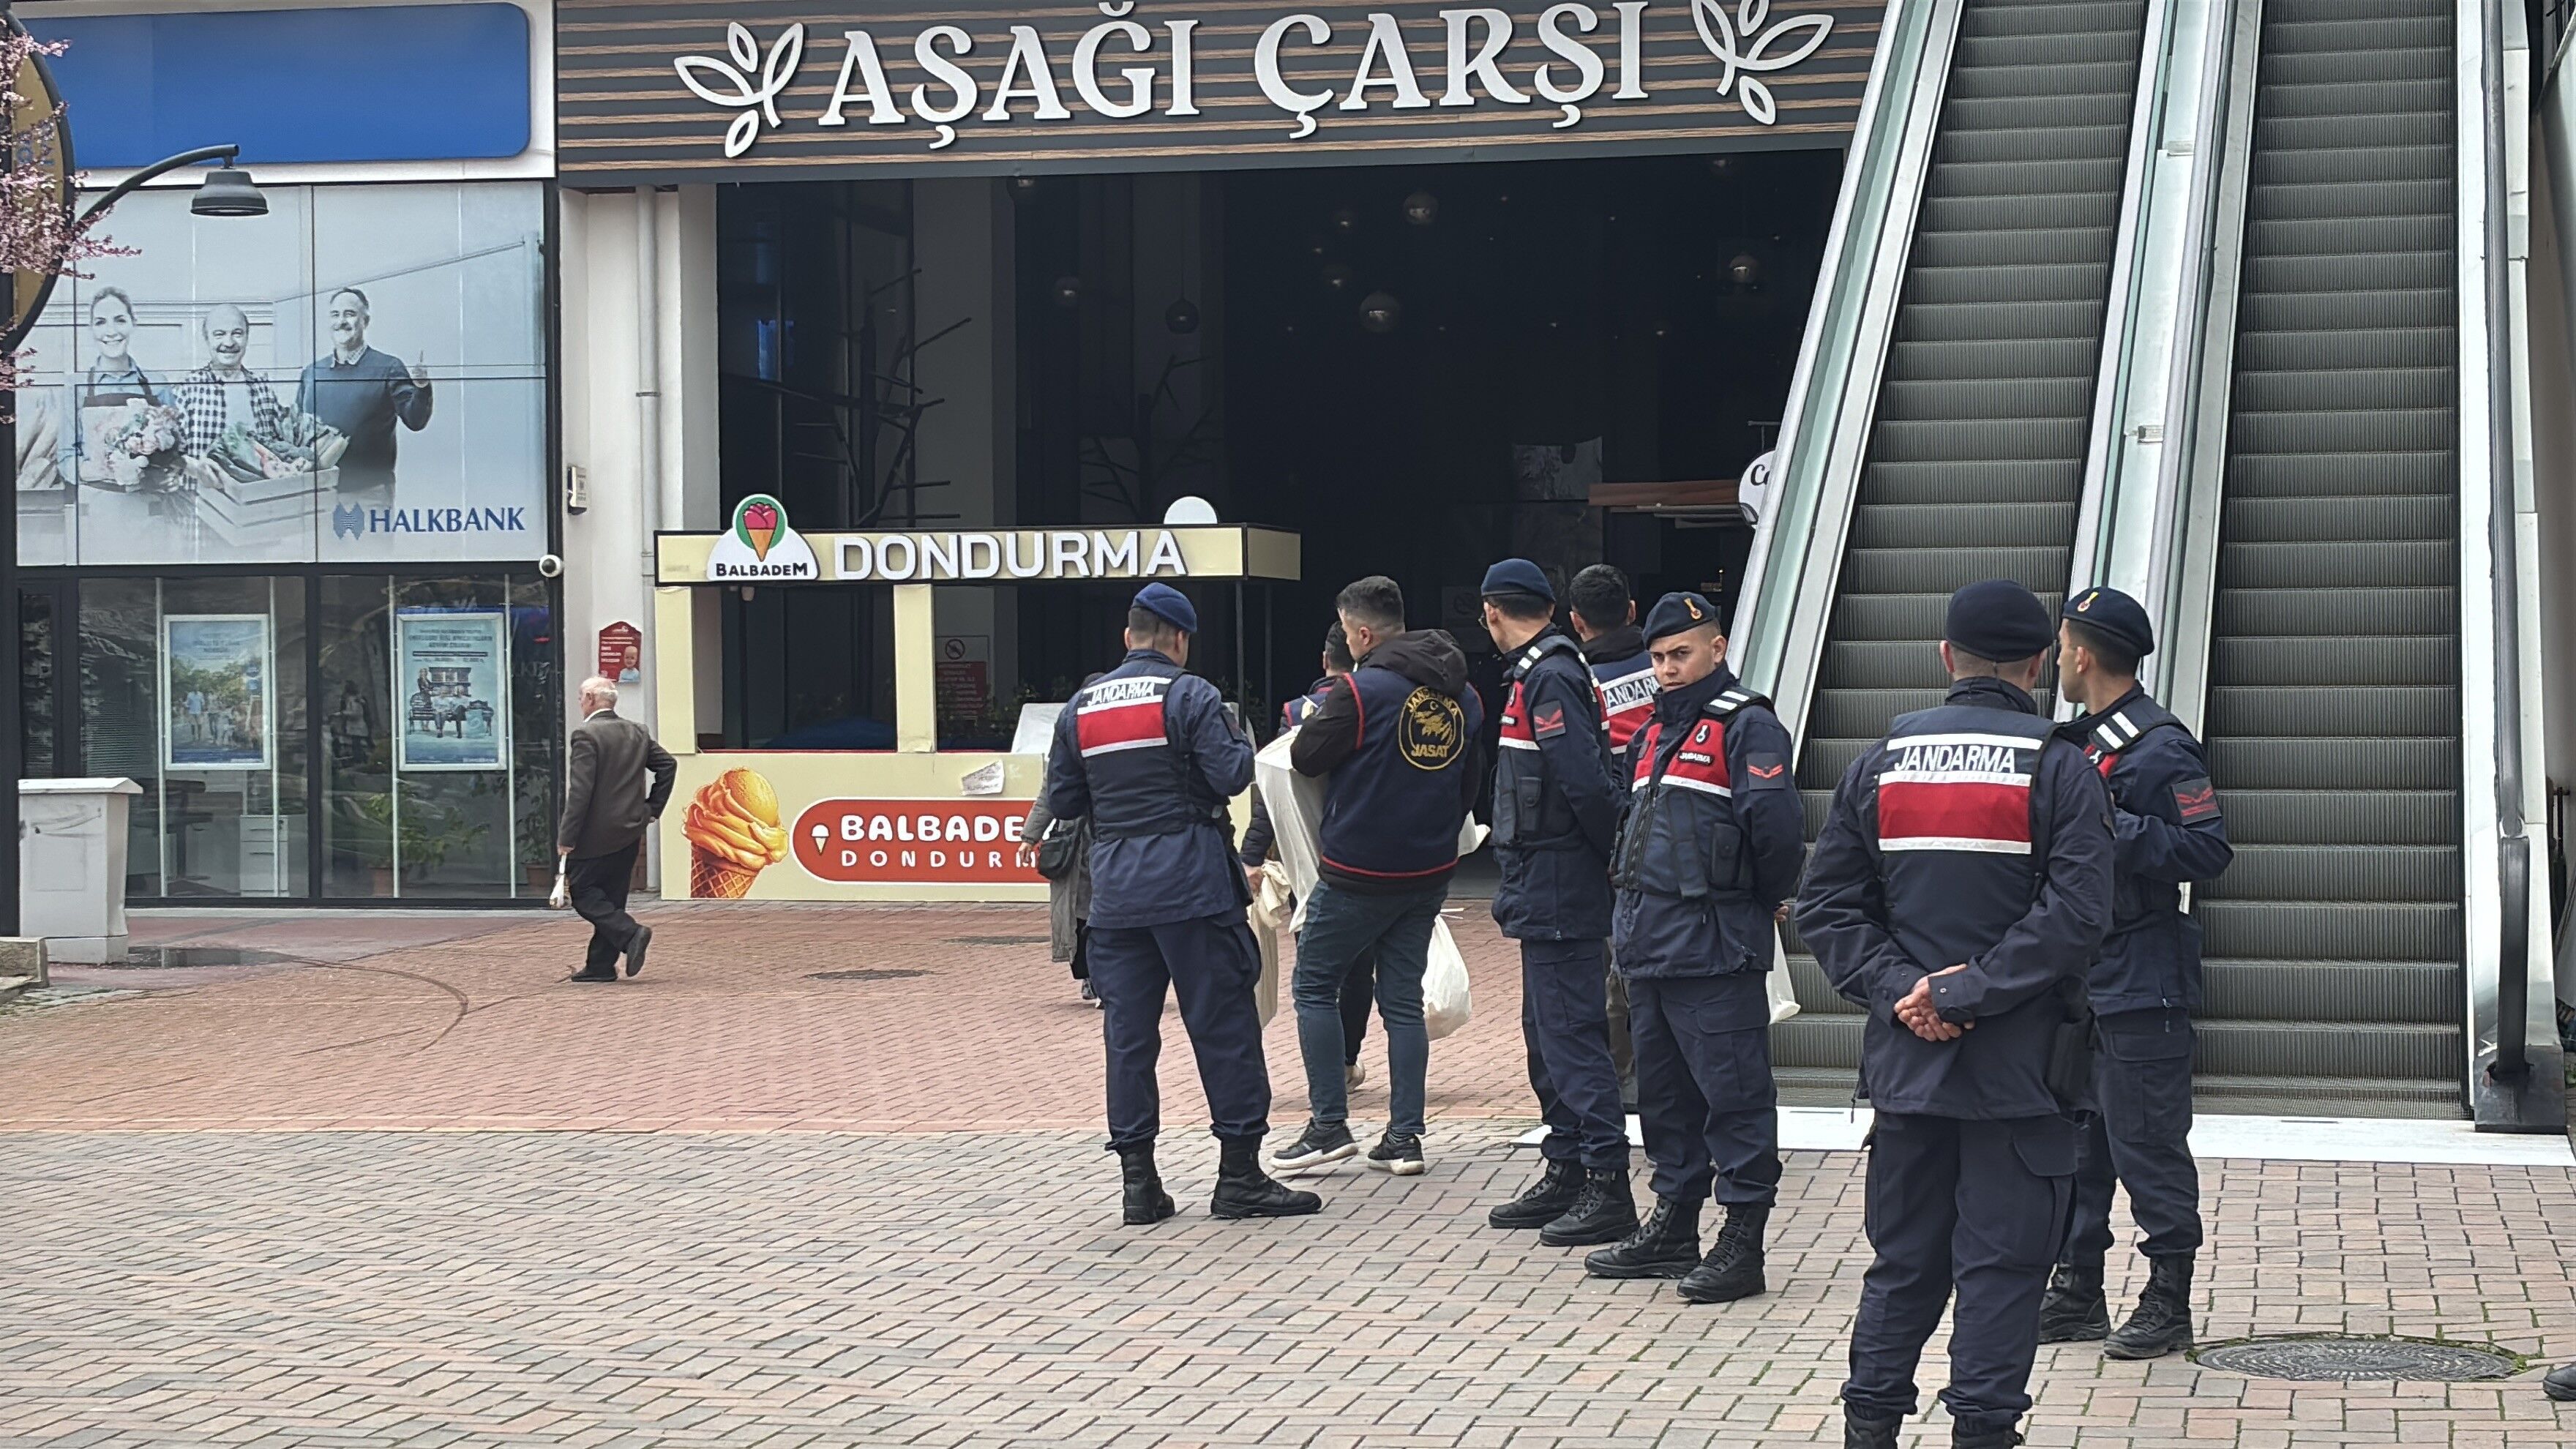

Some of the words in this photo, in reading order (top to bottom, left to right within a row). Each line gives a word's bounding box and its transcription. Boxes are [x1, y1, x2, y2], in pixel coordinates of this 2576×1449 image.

[817, 0, 1200, 150] AŞAĞI
[1254, 1, 1650, 139] ÇARŞI
[370, 506, 525, 533] HALKBANK
[834, 531, 1189, 580] DONDURMA
[716, 562, 809, 577] BALBADEM
[1087, 681, 1156, 707] JANDARMA
[1410, 744, 1452, 758] JASAT
[1894, 744, 2015, 774] JANDARMA
[841, 815, 1056, 842] BALBADE
[841, 850, 1036, 869] DONDURM
